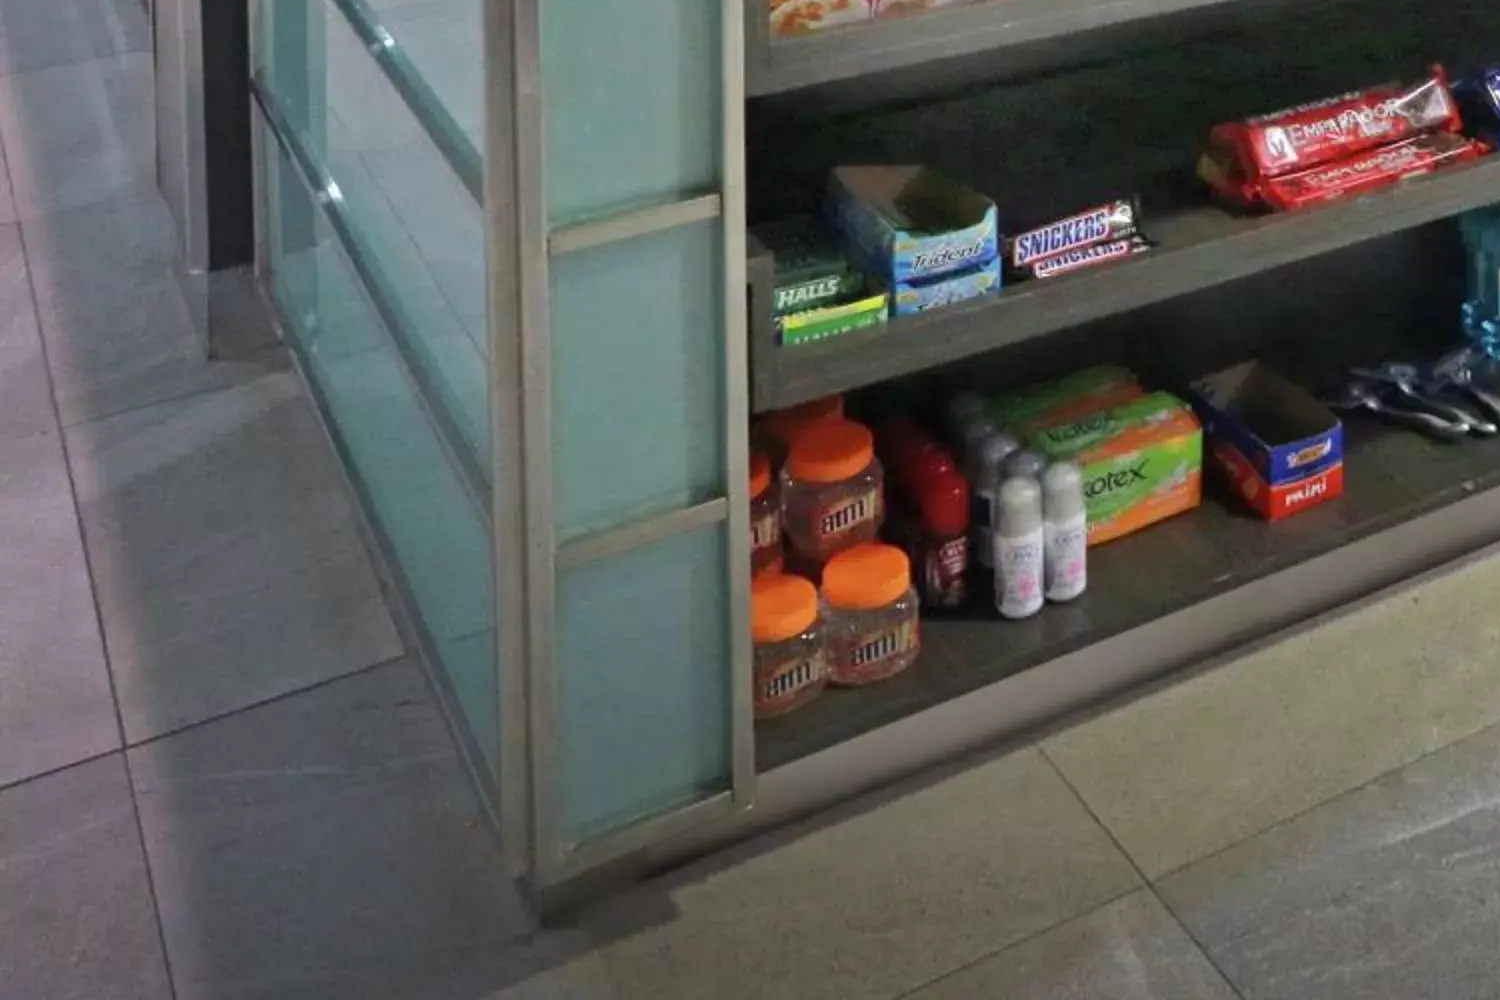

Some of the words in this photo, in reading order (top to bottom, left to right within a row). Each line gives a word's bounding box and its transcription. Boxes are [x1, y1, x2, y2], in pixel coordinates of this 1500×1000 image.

[1018, 211, 1107, 262] SNICKERS
[911, 238, 985, 272] Trident
[776, 274, 842, 310] HALLS
[1285, 476, 1328, 508] mini
